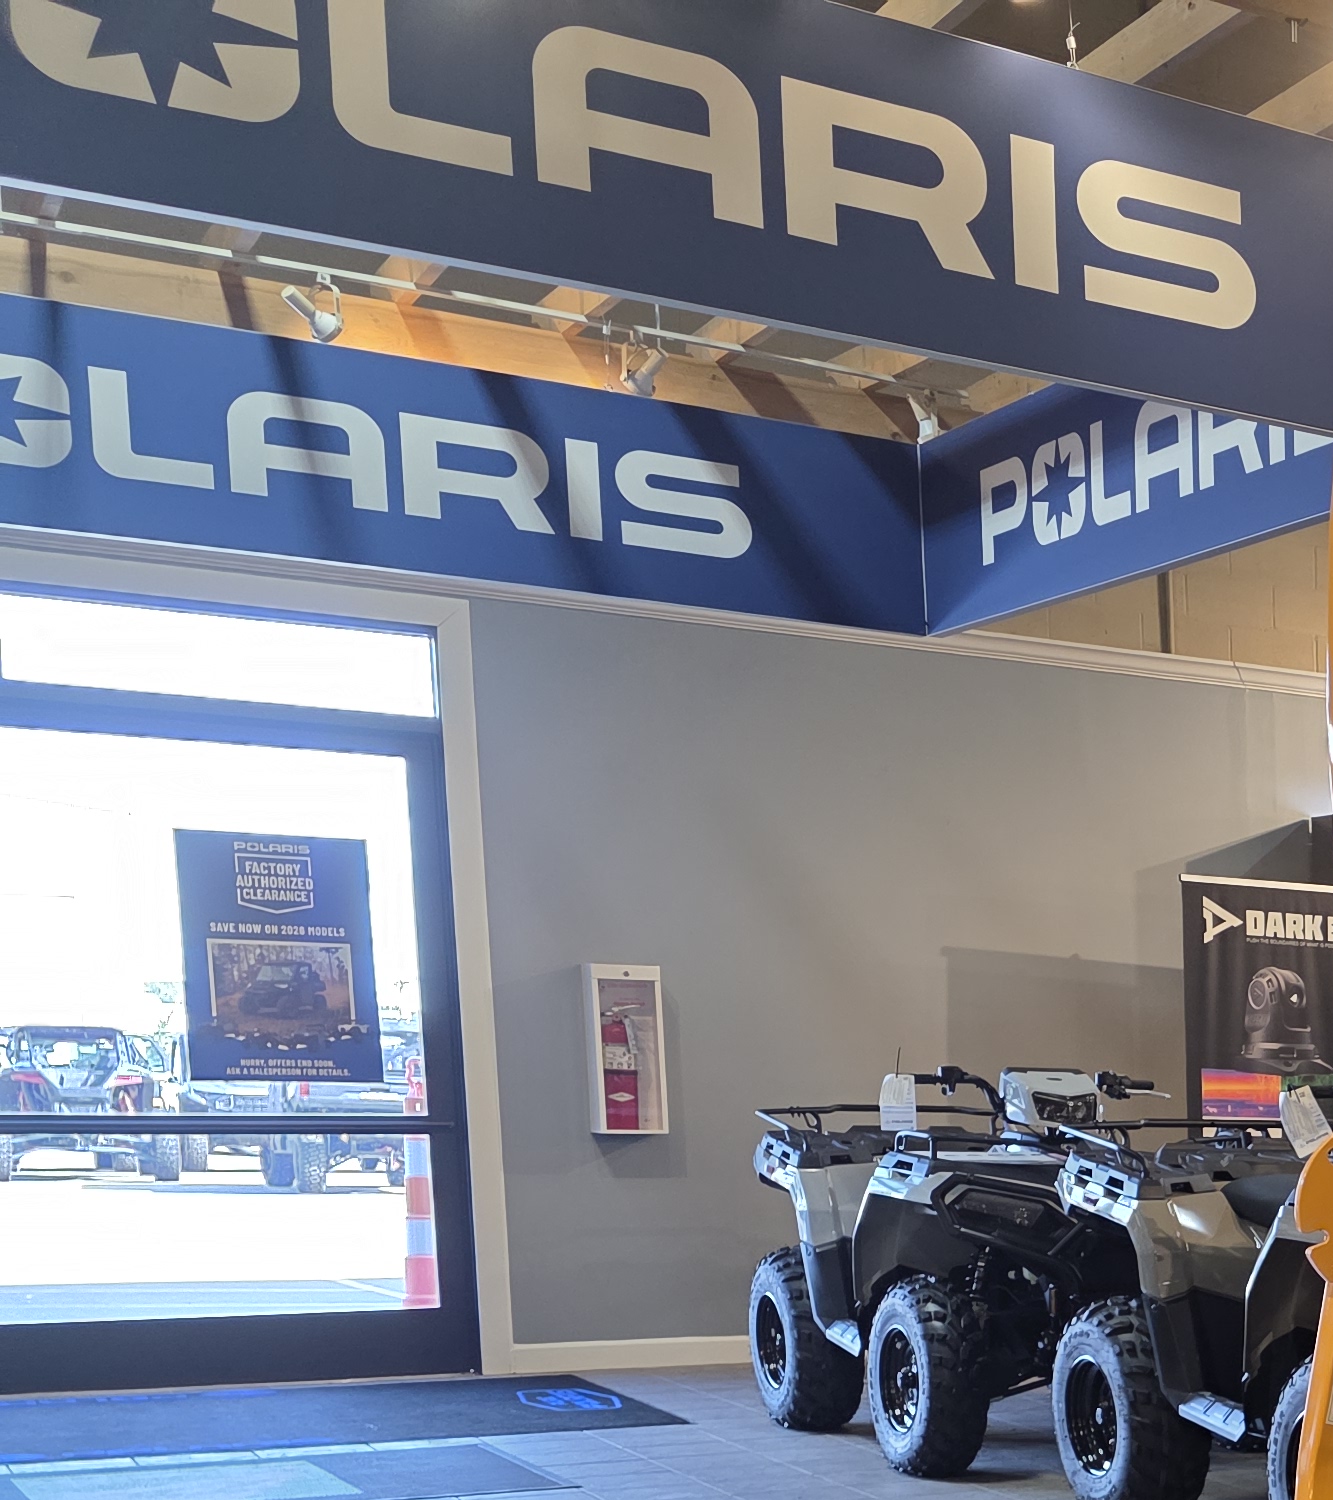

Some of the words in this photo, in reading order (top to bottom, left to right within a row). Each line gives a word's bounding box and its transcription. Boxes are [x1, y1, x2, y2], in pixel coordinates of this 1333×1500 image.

[233, 841, 311, 854] POLARIS
[244, 860, 301, 876] FACTORY
[235, 874, 314, 891] AUTHORIZED
[242, 888, 309, 903] CLEARANCE
[209, 922, 236, 933] SAVE
[238, 923, 262, 934] NOW
[264, 925, 279, 935] ON
[307, 926, 346, 937] MODELS
[1245, 909, 1324, 941] DARK
[268, 1059, 296, 1068] OFFERS
[297, 1060, 313, 1068] END
[226, 1067, 242, 1075] ASK
[242, 1067, 249, 1075] A
[249, 1068, 302, 1076] SALESPERSON
[302, 1068, 318, 1076] FOR
